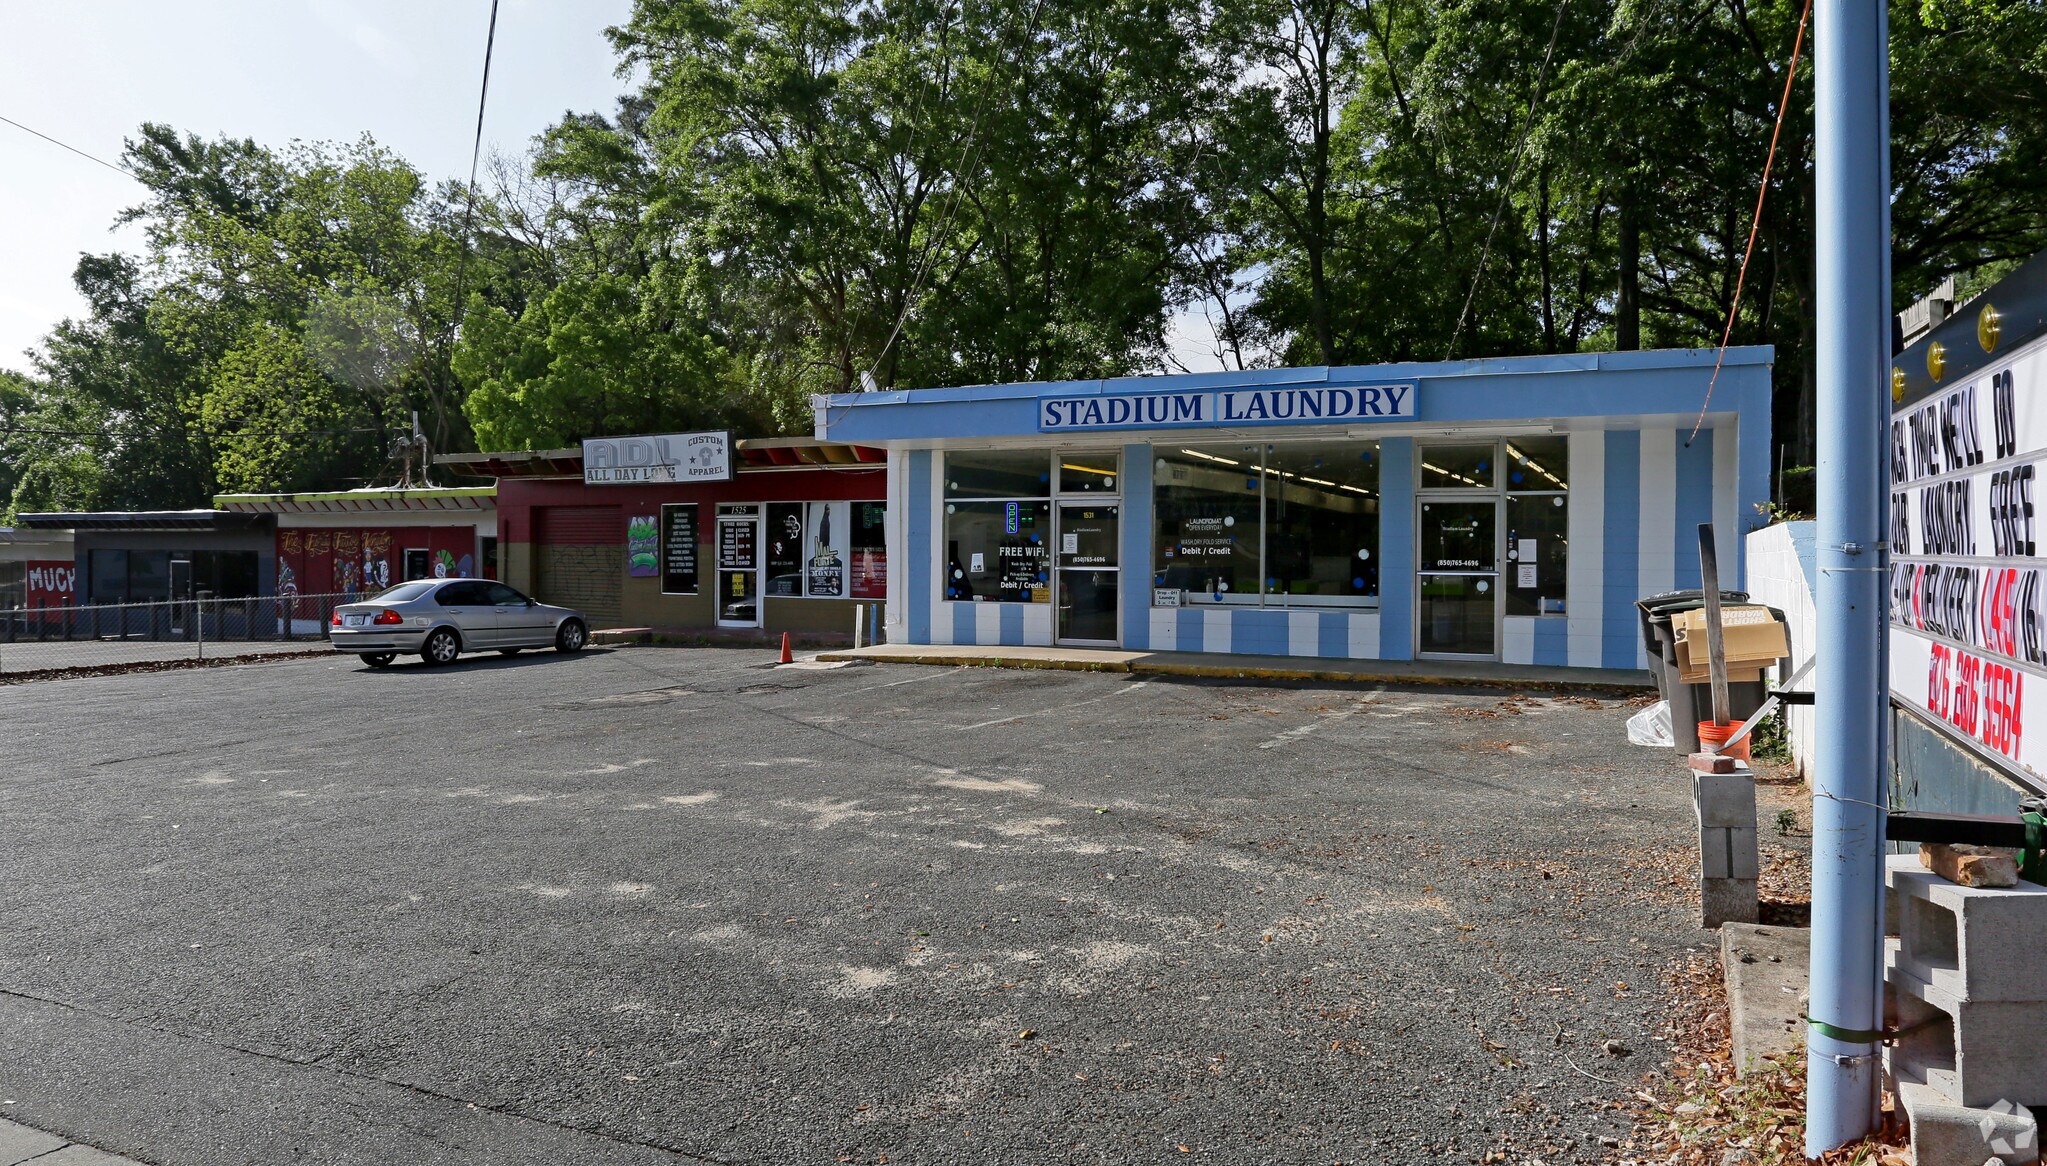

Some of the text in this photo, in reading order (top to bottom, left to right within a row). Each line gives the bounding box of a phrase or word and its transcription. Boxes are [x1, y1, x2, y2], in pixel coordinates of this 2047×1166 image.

[1045, 386, 1409, 427] STADIUM LAUNDRY
[1940, 386, 1984, 472] WE'LL
[1992, 368, 2016, 460] DO
[688, 435, 723, 447] CUSTOM
[585, 439, 681, 467] ADL
[587, 469, 610, 481] ALL
[614, 468, 639, 481] DAY
[688, 466, 724, 476] APPAREL
[731, 506, 747, 515] 1525
[1990, 465, 2036, 557] FREE
[1008, 504, 1016, 532] OPEN
[999, 546, 1045, 557] FREE WiFi
[1181, 547, 1201, 555] Debit
[1208, 547, 1231, 555] Credit
[1437, 559, 1479, 567] (850)765-4696
[1000, 581, 1018, 589] Debit
[1024, 581, 1044, 589] Credit
[1912, 565, 1924, 630] &
[1982, 661, 2022, 762] 3564
